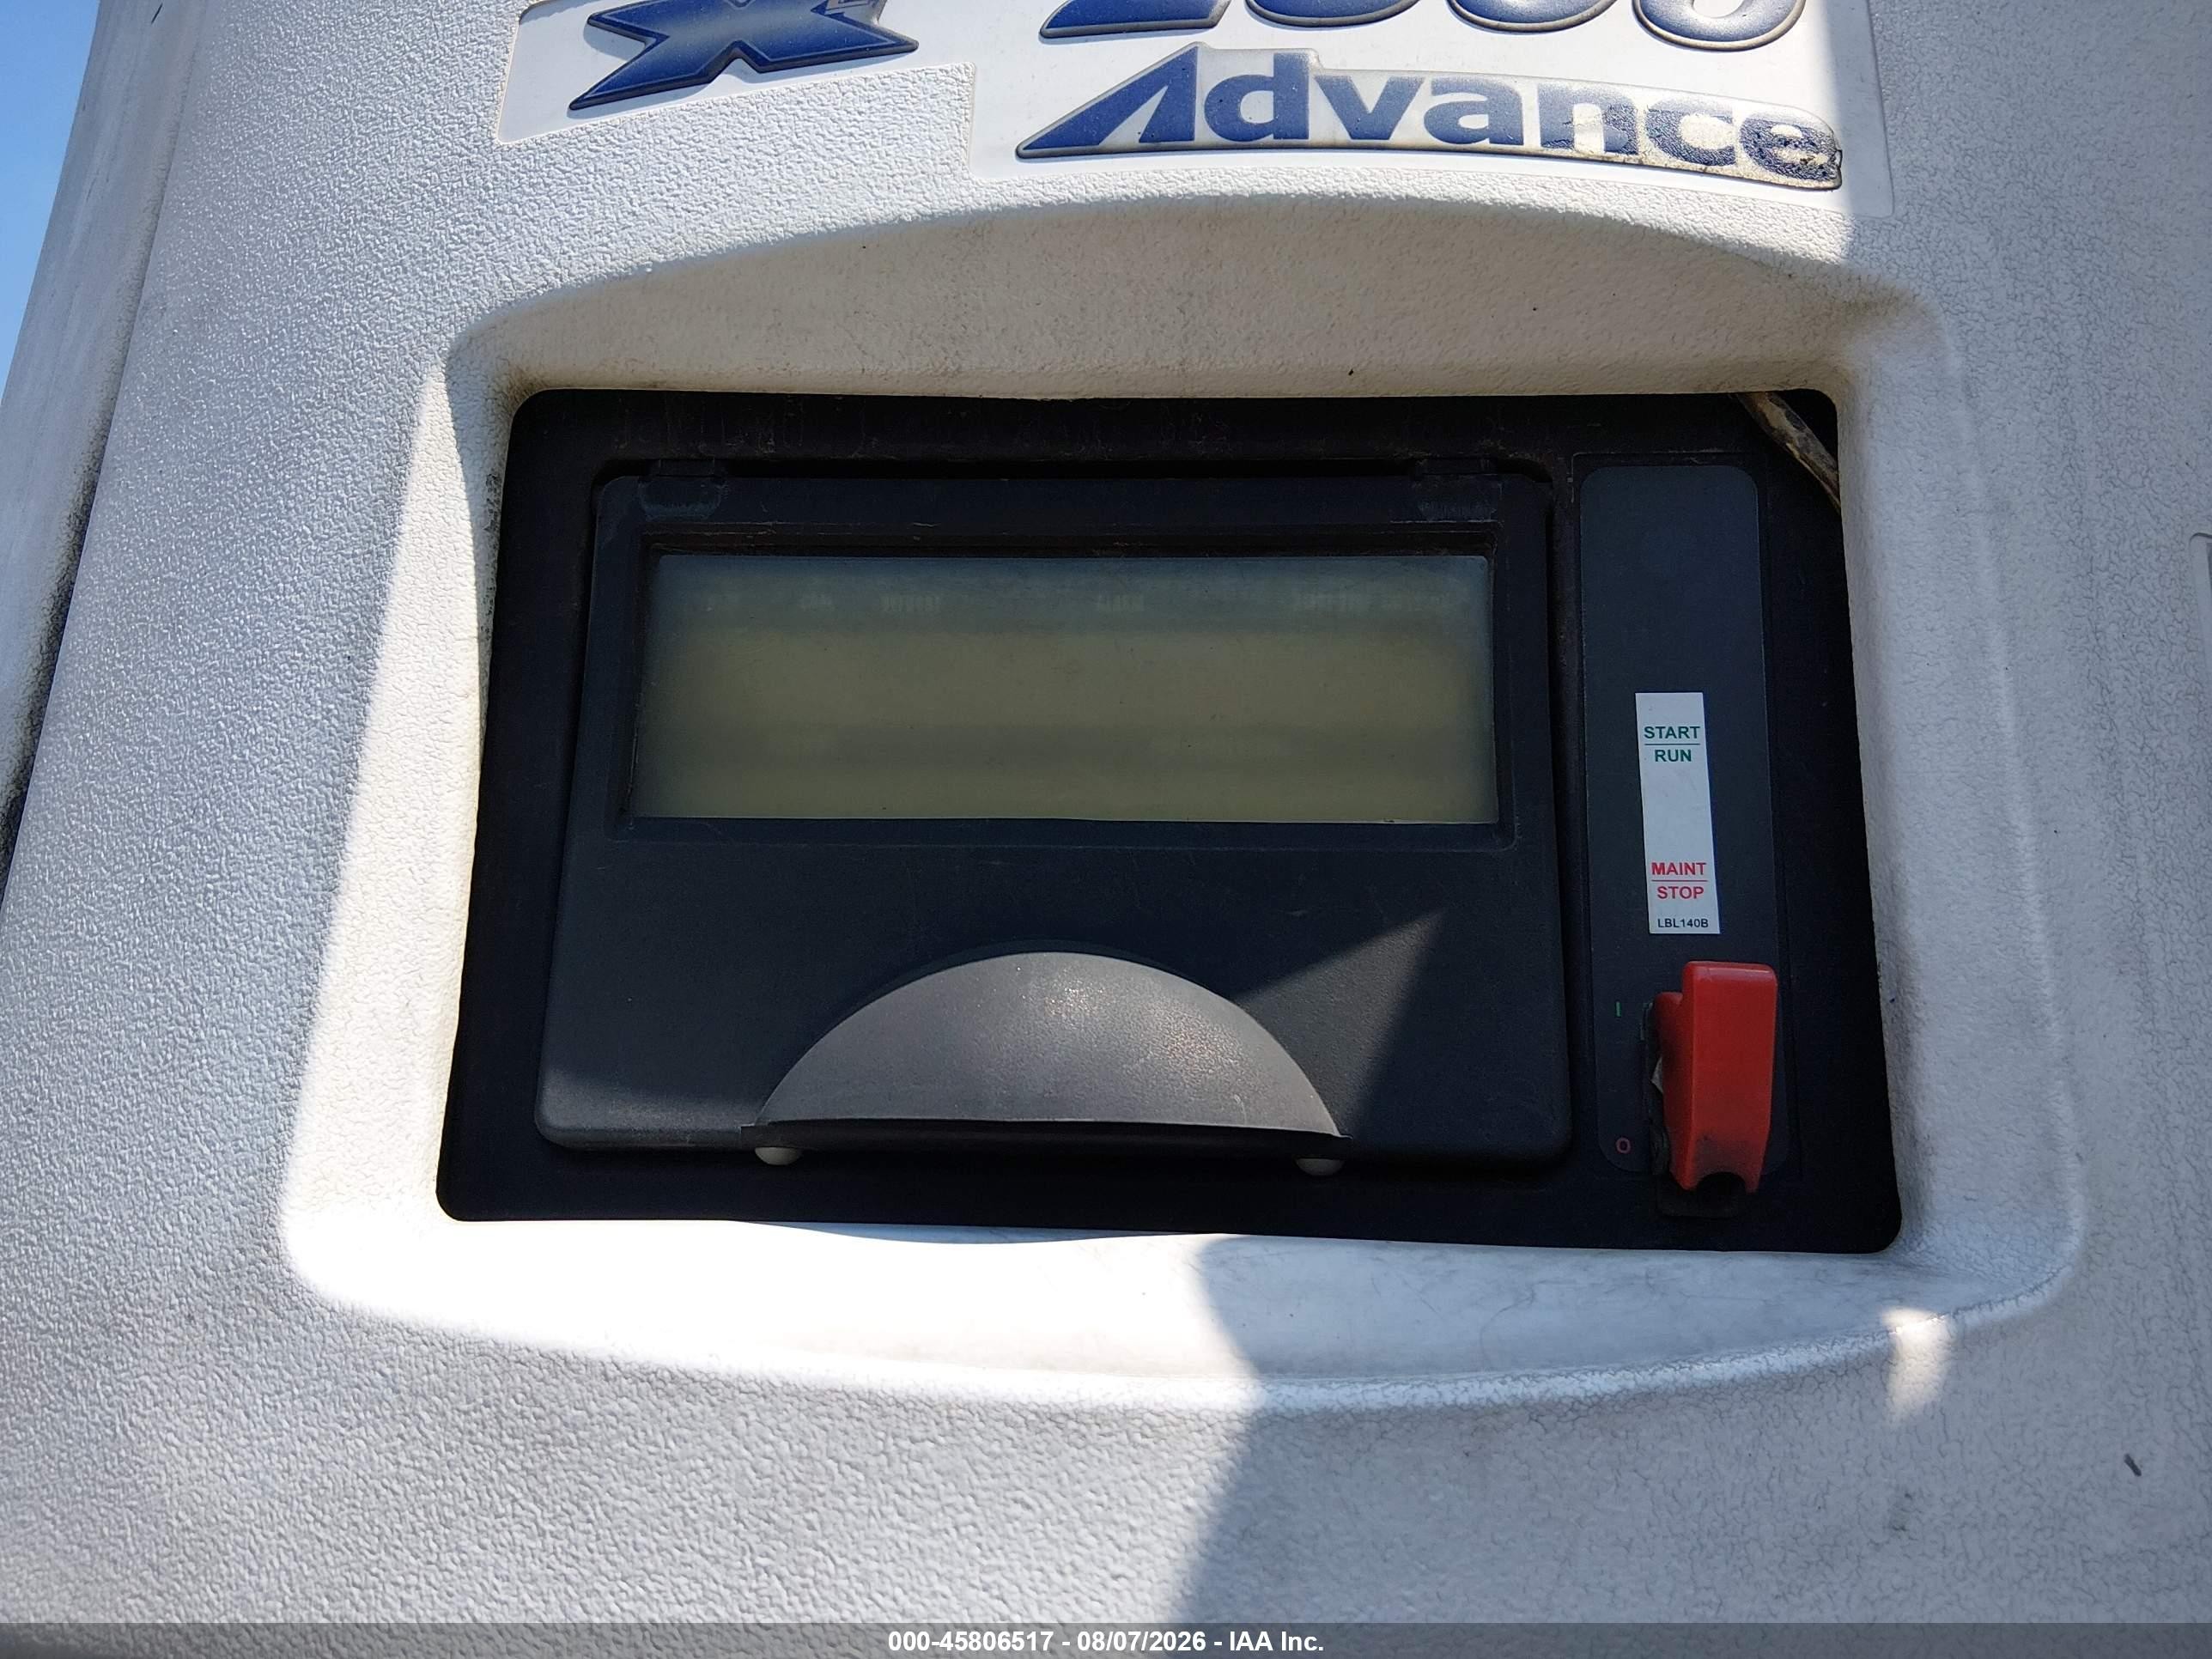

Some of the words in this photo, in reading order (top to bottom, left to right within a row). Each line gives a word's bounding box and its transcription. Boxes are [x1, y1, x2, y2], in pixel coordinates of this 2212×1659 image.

[1020, 46, 1839, 184] Advance
[1644, 726, 1701, 739] START
[1655, 750, 1692, 762] RUN
[1651, 862, 1706, 876] MAINT
[1657, 886, 1705, 899] STOP
[1657, 919, 1709, 928] LBL140B
